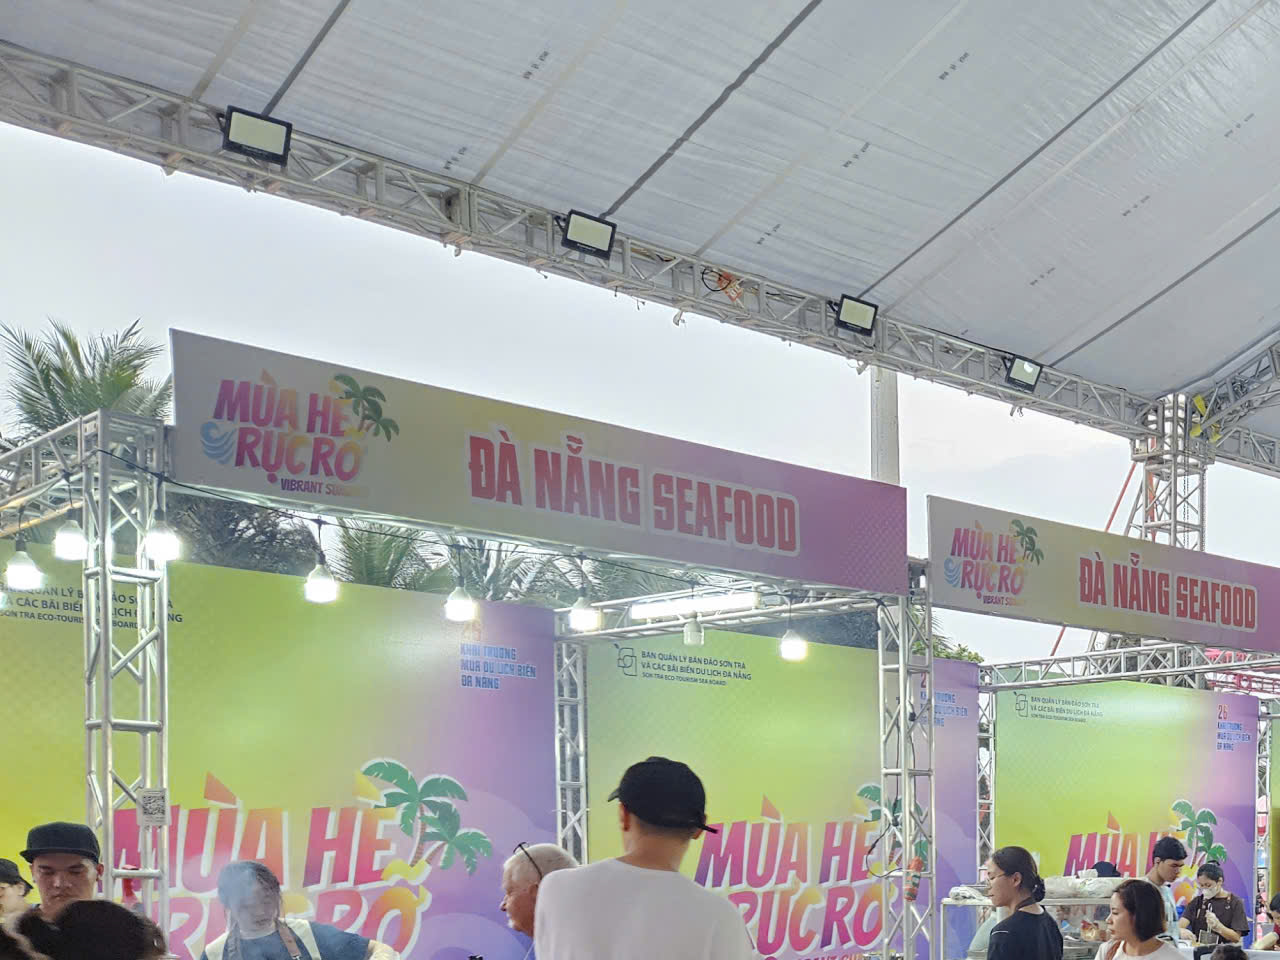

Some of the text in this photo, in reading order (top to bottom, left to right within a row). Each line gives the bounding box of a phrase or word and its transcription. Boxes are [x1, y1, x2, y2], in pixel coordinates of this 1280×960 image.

[213, 368, 299, 428] MÙA
[281, 478, 323, 494] VIBRANT
[468, 430, 797, 551] ĐÀ NẴNG SEAFOOD
[1079, 552, 1257, 629] ĐÀ NẴNG SEAFOOD
[62, 600, 83, 612] BIỂ
[20, 611, 36, 620] TRA
[38, 612, 84, 624] ECO-TOURI
[641, 651, 657, 659] BAN
[695, 667, 706, 675] DU
[694, 794, 809, 889] MÙA
